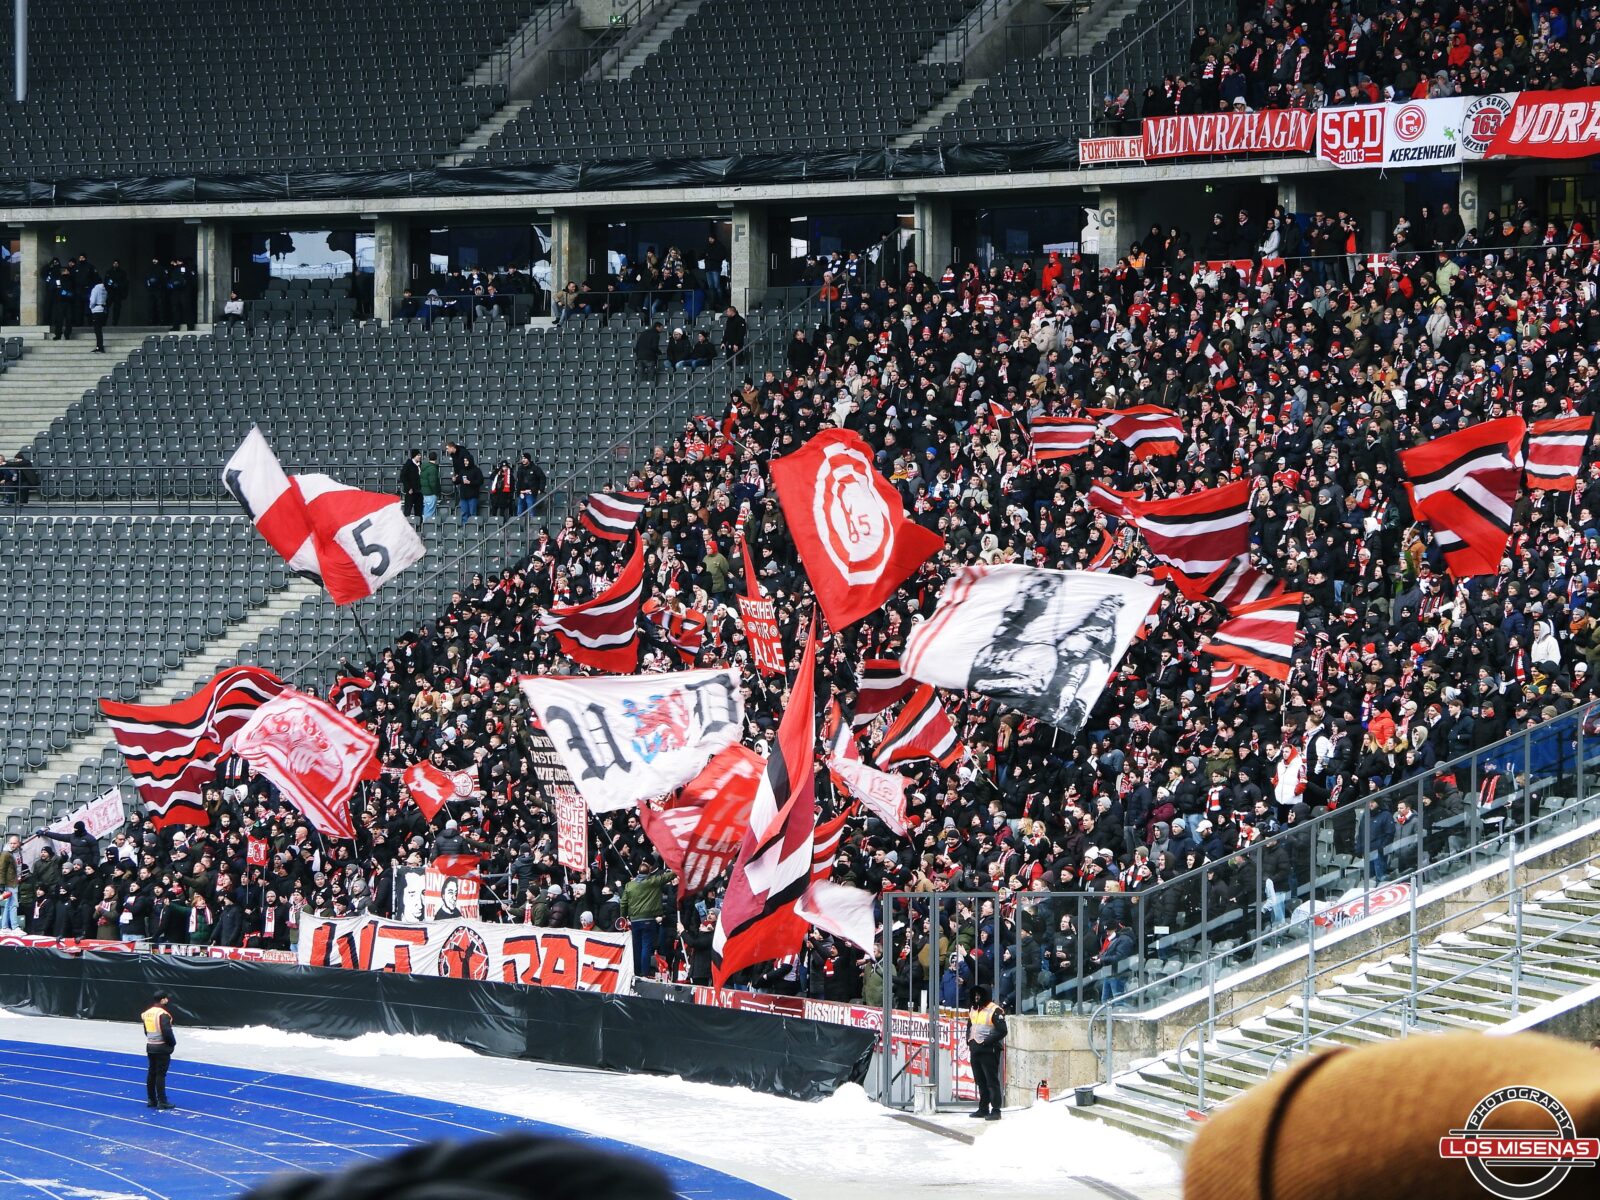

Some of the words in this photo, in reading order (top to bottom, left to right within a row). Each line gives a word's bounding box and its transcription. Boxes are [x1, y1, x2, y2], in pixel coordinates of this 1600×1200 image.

[1146, 110, 1317, 157] MEINERZHAGEN
[1323, 109, 1381, 150] SCD
[1081, 139, 1125, 161] FORTUNA
[1389, 143, 1457, 163] KERZENHEIM
[1463, 135, 1489, 151] UNTERR
[1339, 151, 1365, 164] 2003
[1461, 190, 1476, 210] G
[1101, 208, 1115, 227] G
[735, 224, 746, 242] F
[352, 518, 390, 577] 5
[753, 638, 787, 672] ALLE
[534, 766, 554, 781] WIE
